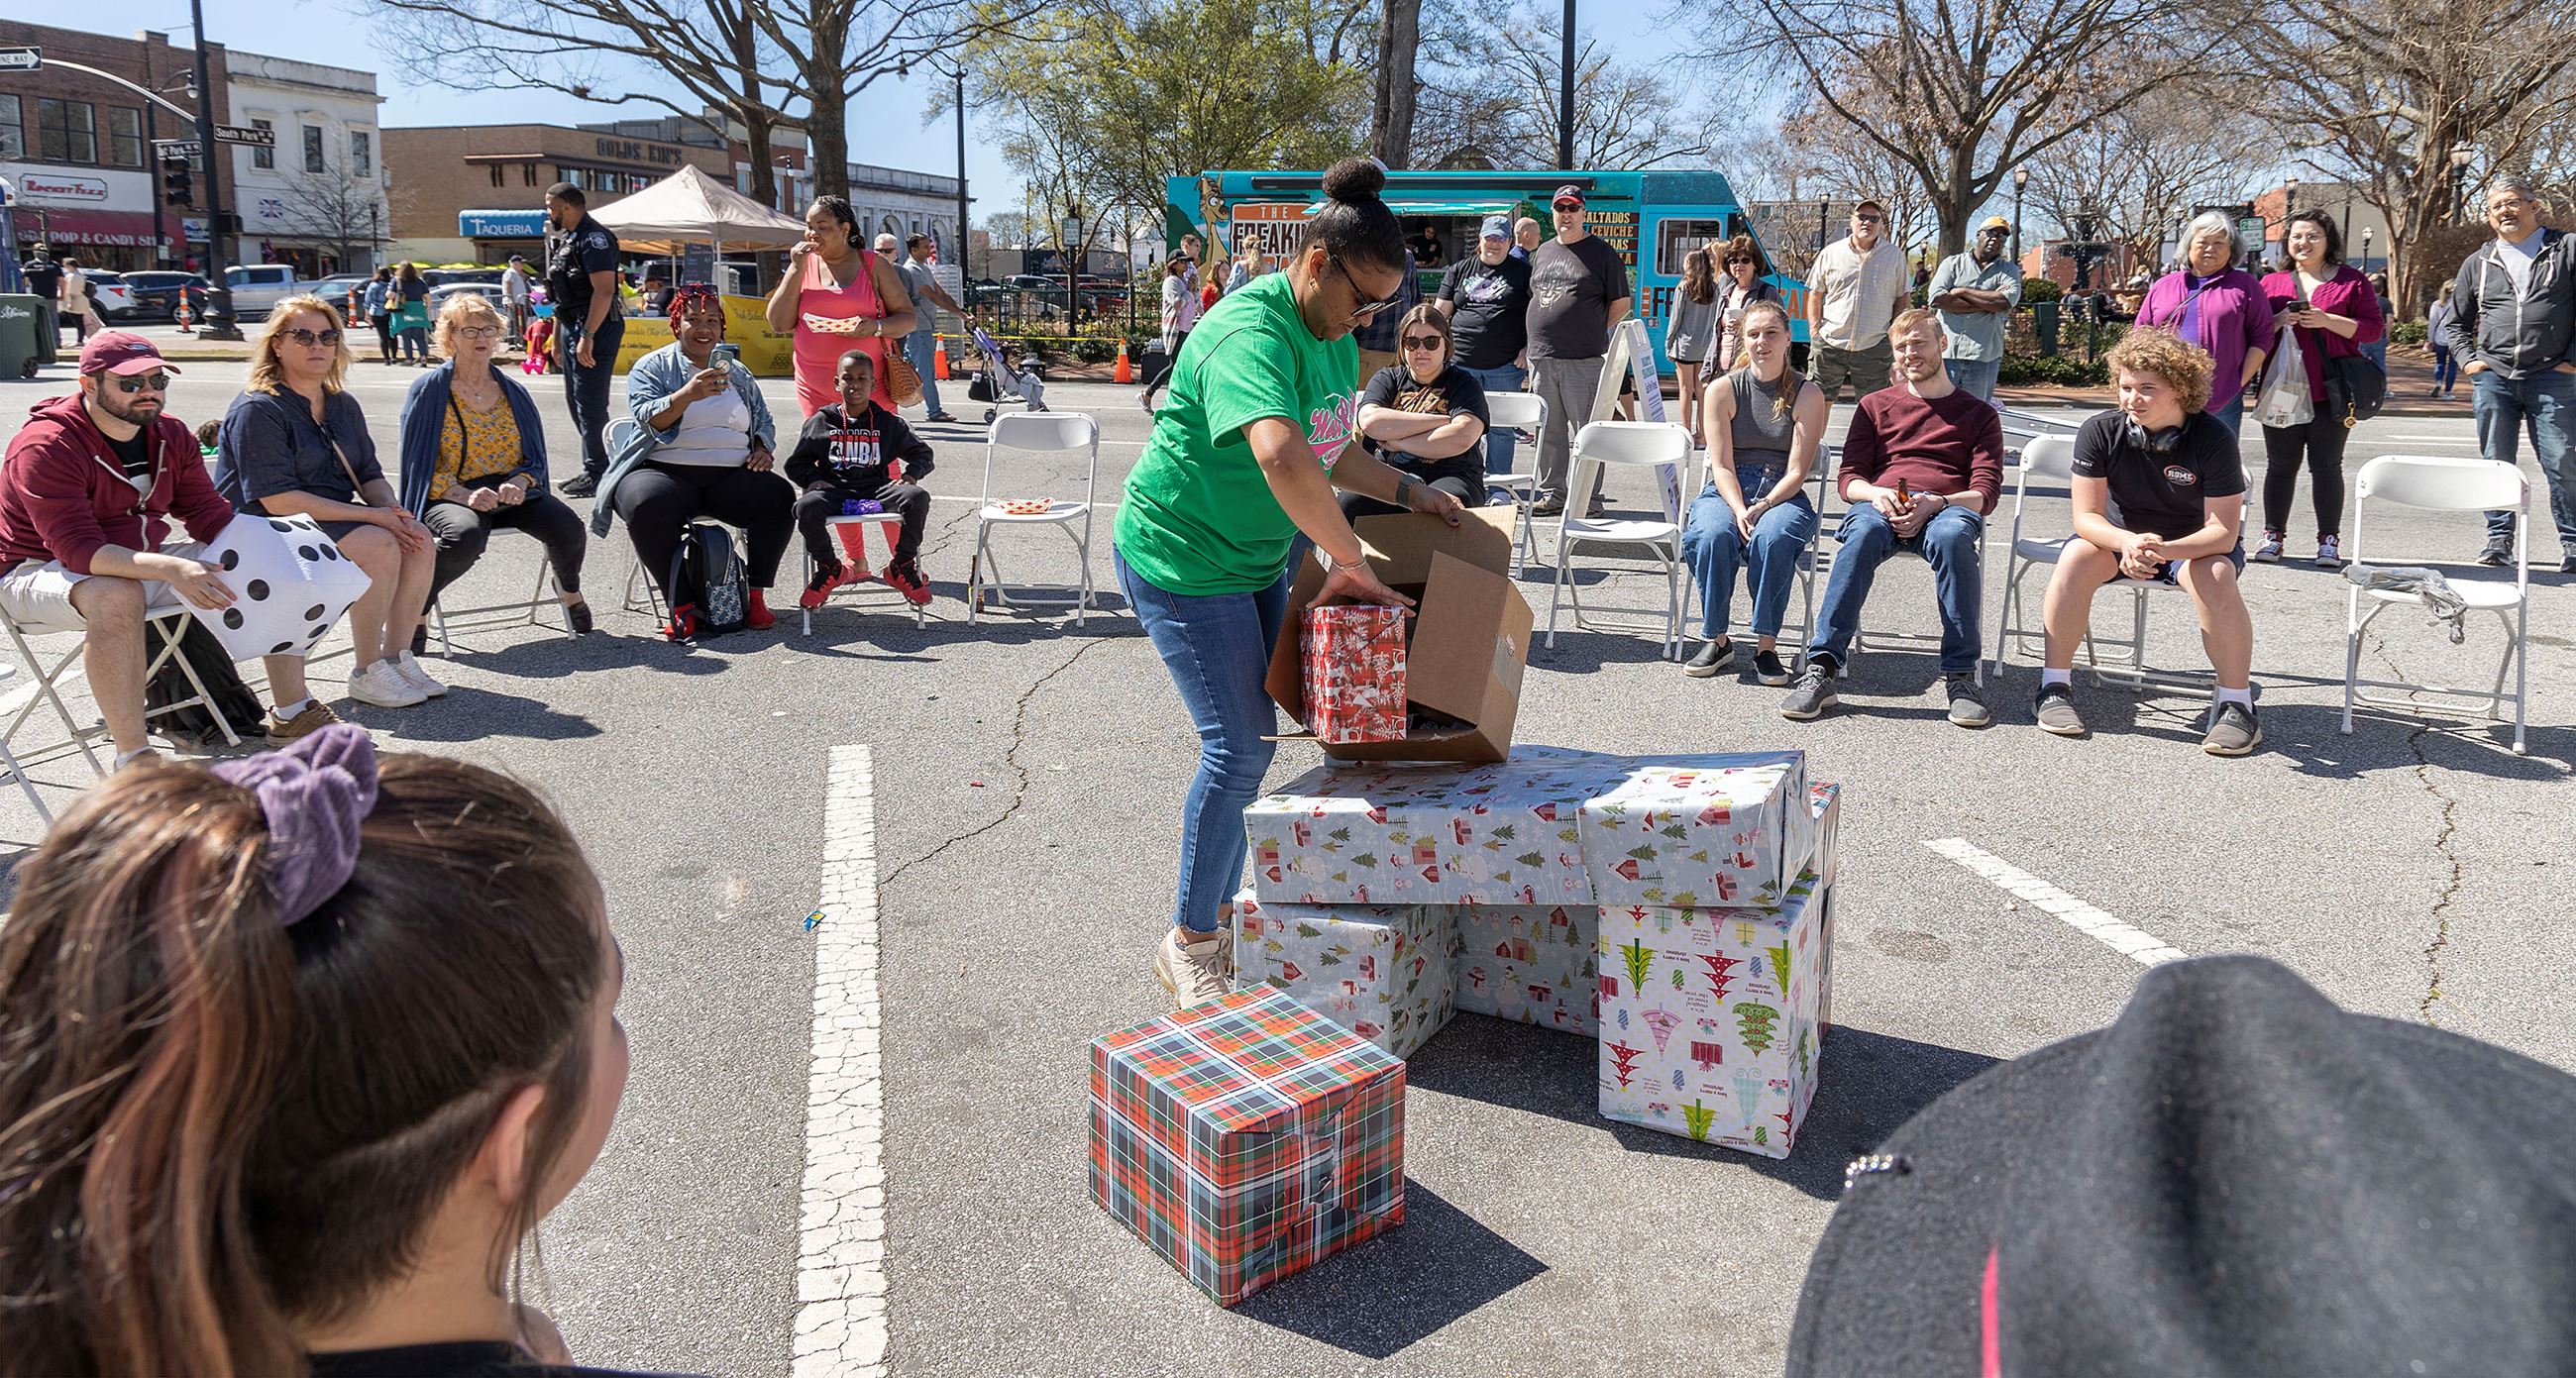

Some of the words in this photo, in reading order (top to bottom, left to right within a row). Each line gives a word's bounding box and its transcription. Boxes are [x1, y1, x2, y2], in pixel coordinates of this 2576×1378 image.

[241, 130, 259, 141] Park
[1260, 206, 1288, 219] THE
[470, 218, 533, 236] TAQUERIA
[1591, 225, 1634, 237] CEVICHE
[51, 232, 78, 244] POP
[81, 232, 91, 244] &
[94, 234, 135, 246] CANDY
[138, 235, 174, 247] SHP
[1233, 223, 1308, 254] FREAKI
[2167, 470, 2194, 480] ROME
